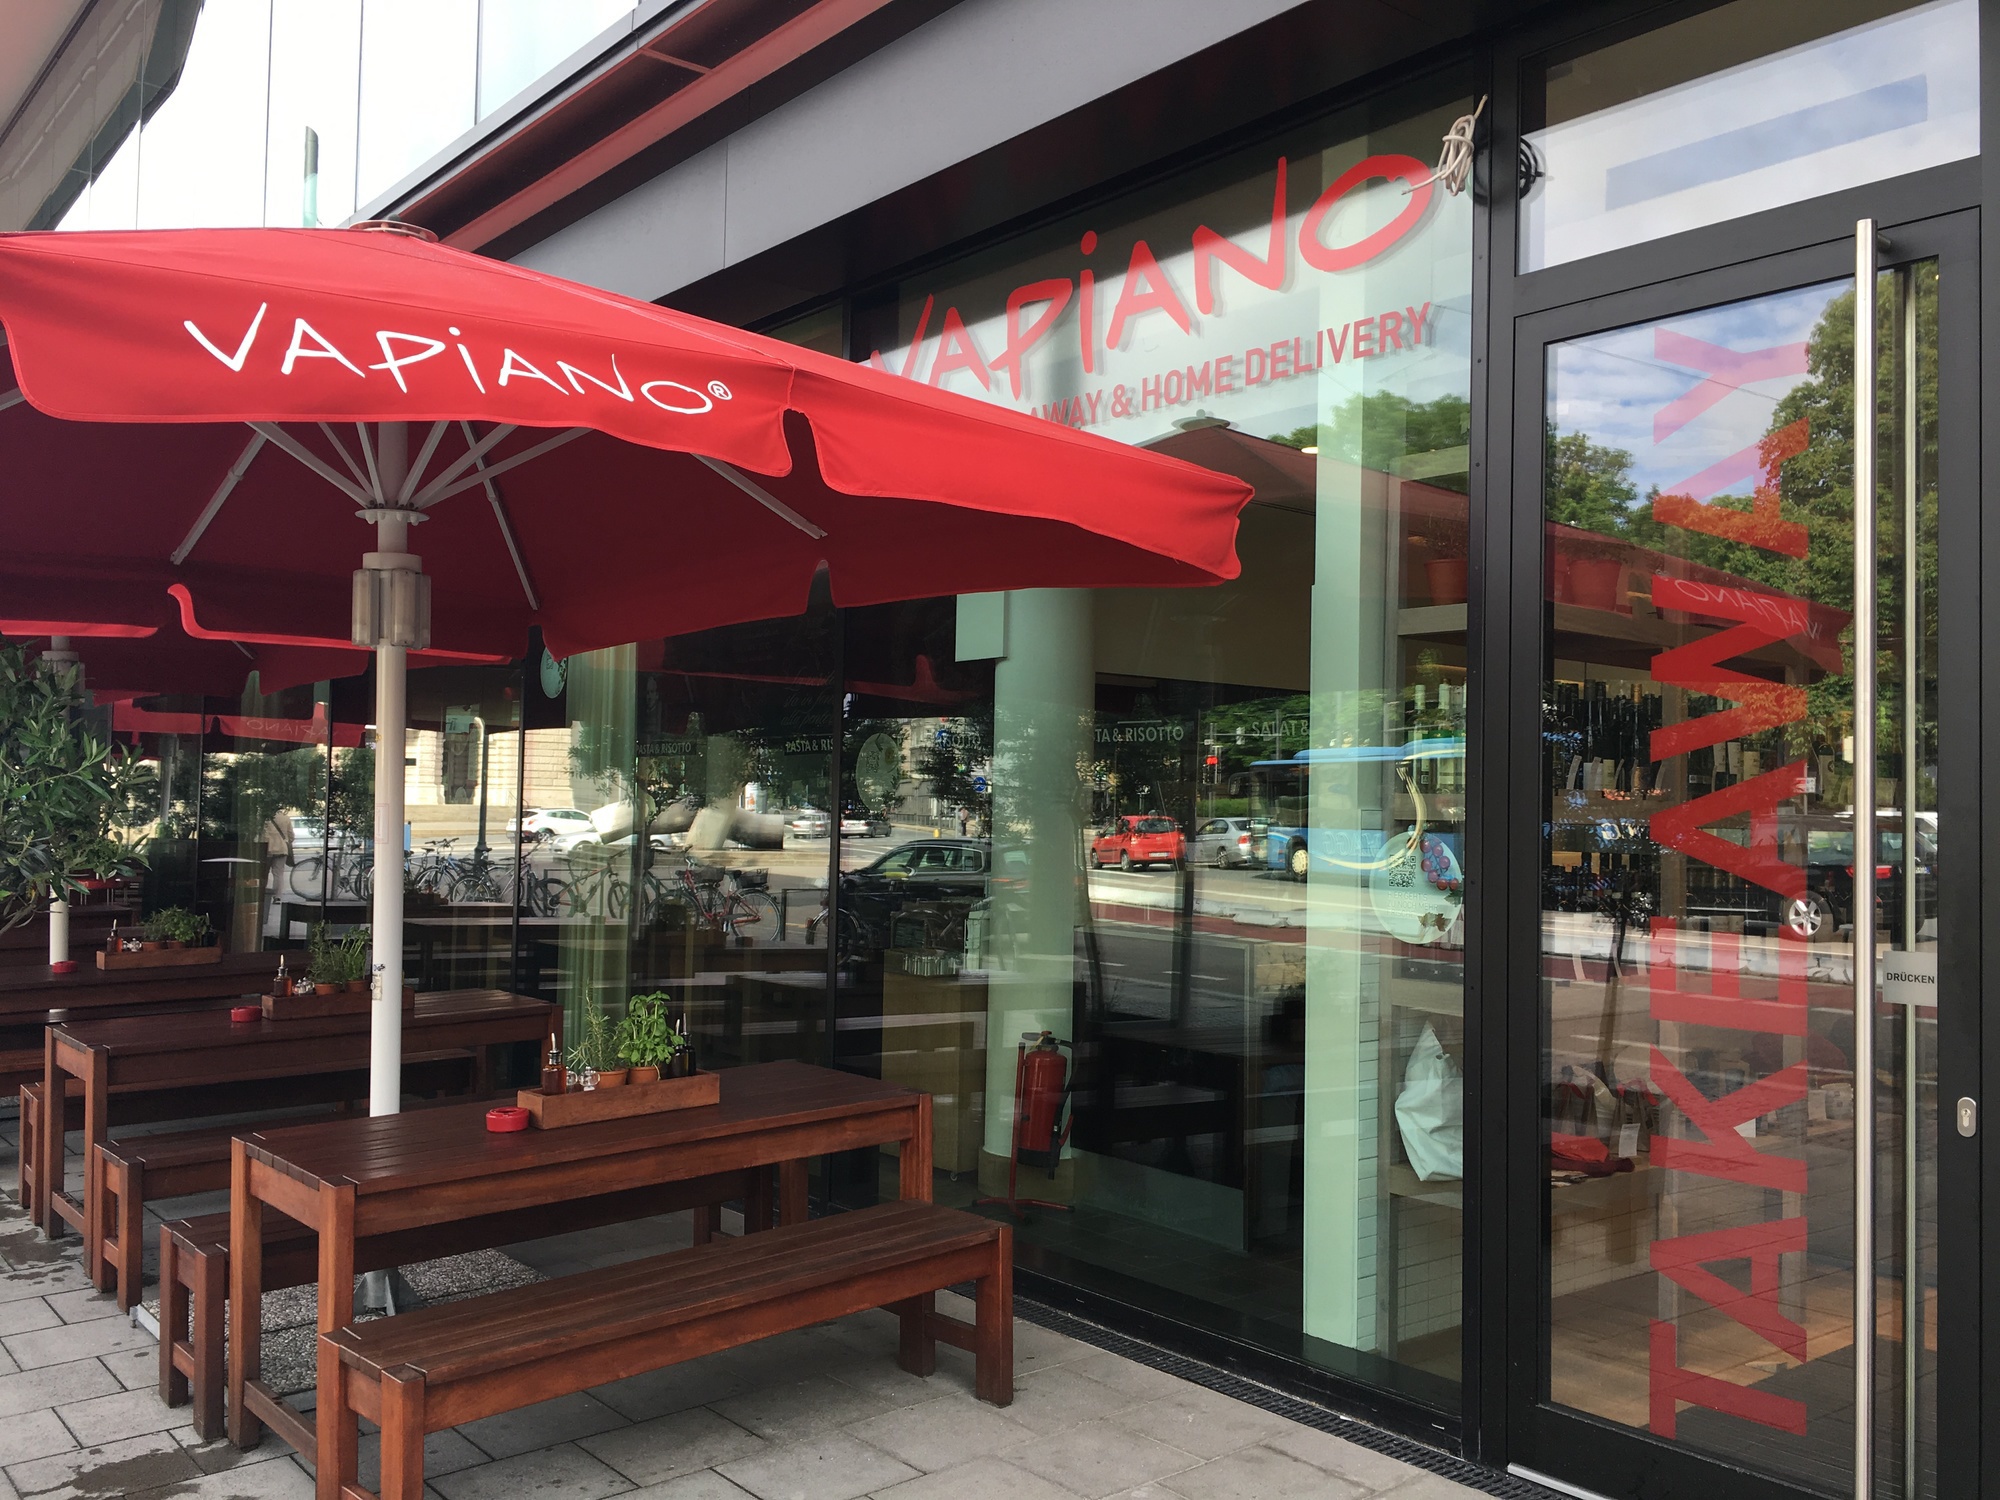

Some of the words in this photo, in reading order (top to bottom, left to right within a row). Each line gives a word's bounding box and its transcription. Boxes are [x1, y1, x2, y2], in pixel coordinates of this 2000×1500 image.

[1111, 384, 1131, 418] &
[1141, 355, 1233, 412] HOME
[1245, 301, 1431, 387] DELIVERY
[1112, 728, 1123, 742] &
[1125, 725, 1184, 742] RISOTTO
[1251, 720, 1298, 737] SALAT
[786, 739, 811, 753] PASTA
[812, 739, 819, 751] &
[1886, 971, 1935, 984] DRÜCKEN
